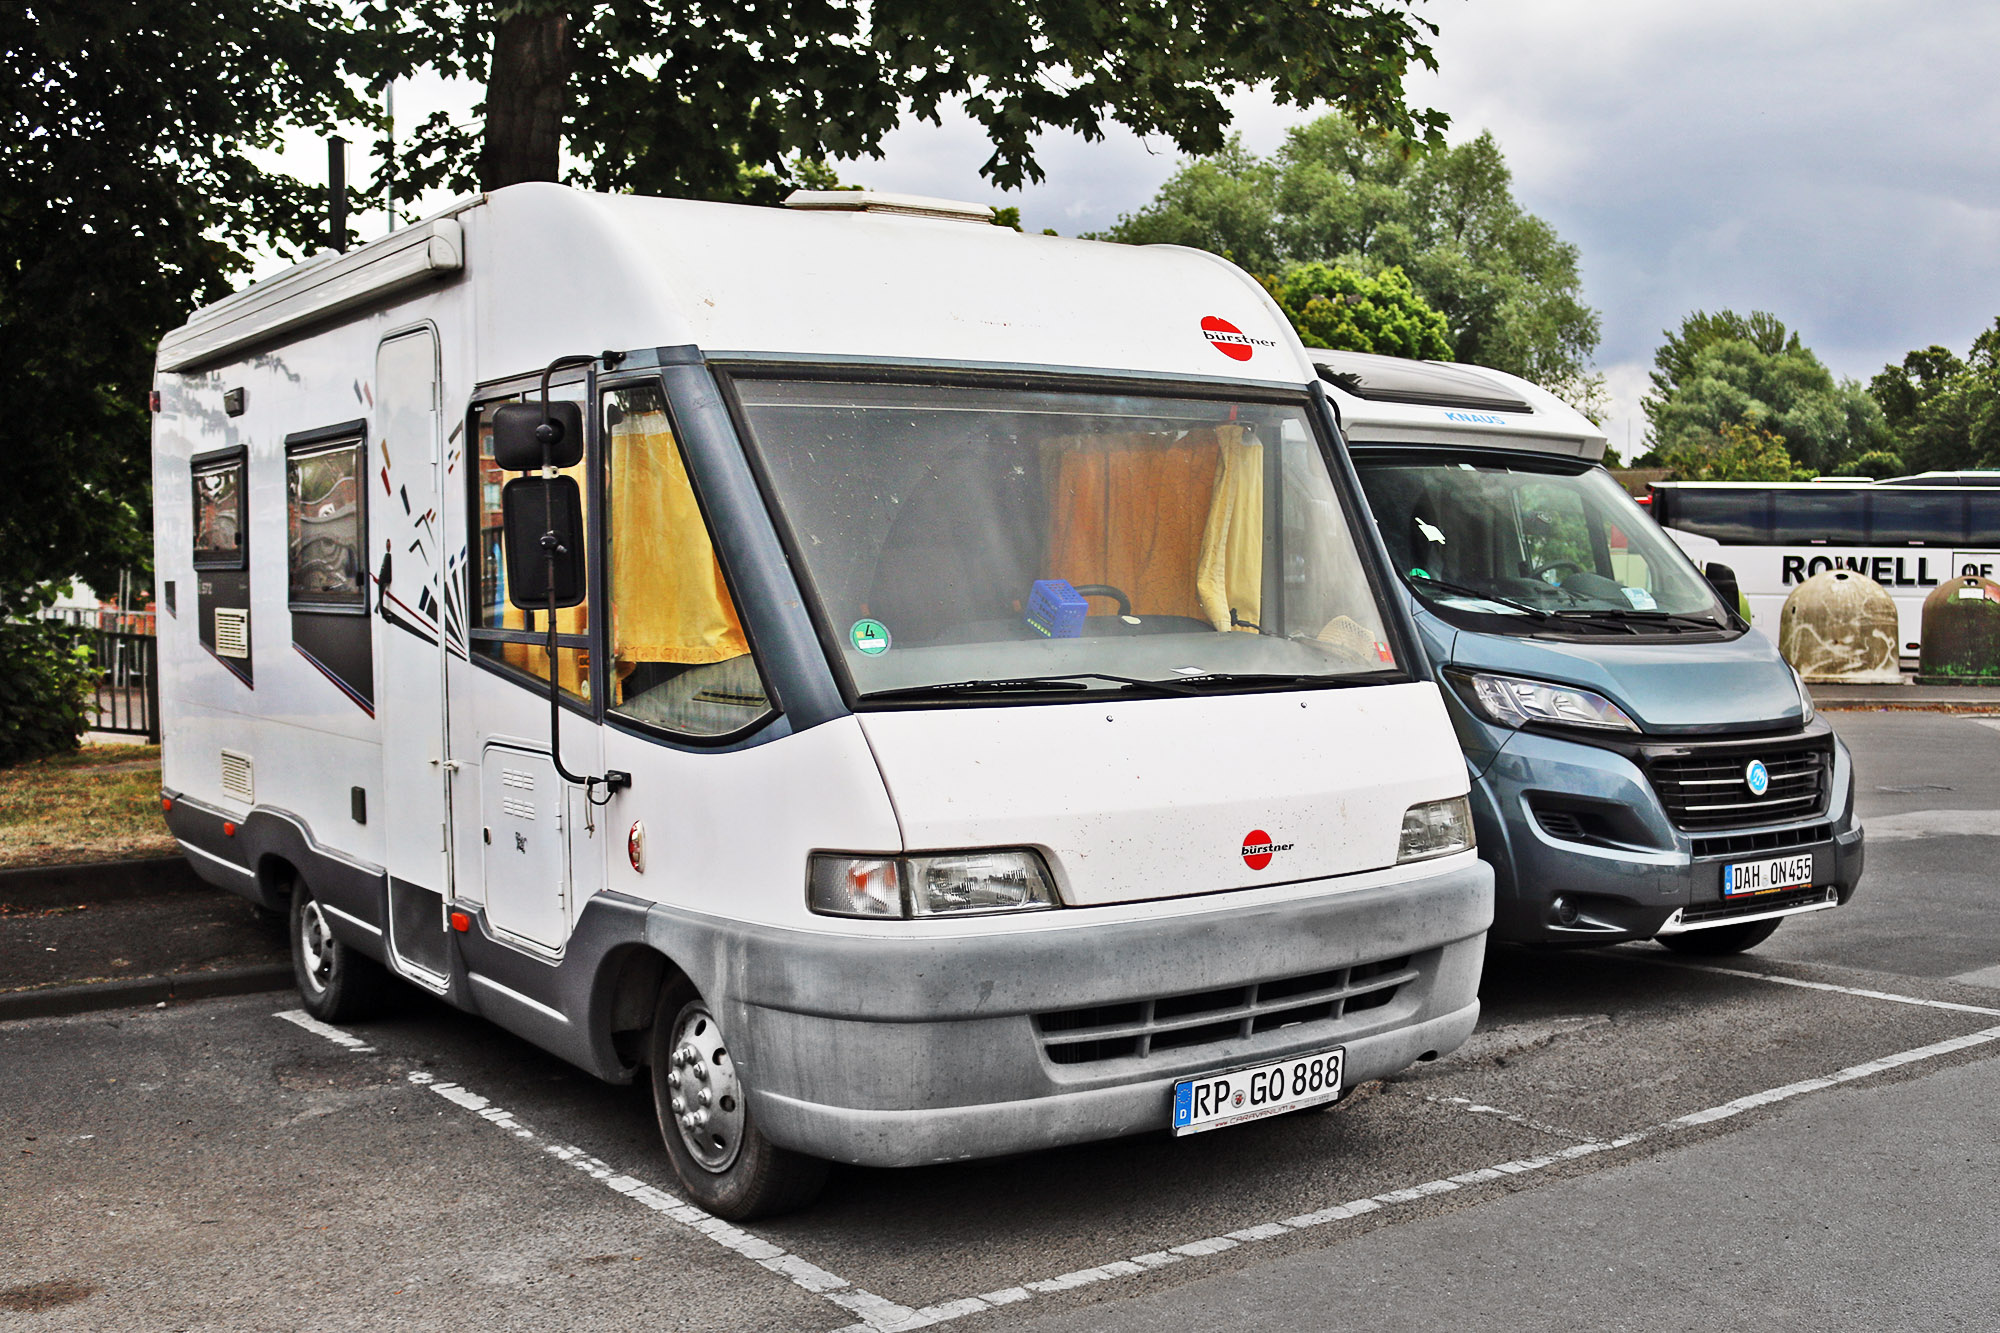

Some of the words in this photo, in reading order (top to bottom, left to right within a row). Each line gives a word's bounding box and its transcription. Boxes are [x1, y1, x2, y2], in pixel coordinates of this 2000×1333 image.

[1203, 330, 1277, 347] bürstner
[1444, 412, 1505, 424] KNAUS
[865, 624, 875, 639] 4
[1241, 843, 1294, 855] bürstner
[1734, 864, 1760, 890] DAH
[1179, 1108, 1188, 1120] D
[1193, 1079, 1231, 1119] RP
[1250, 1067, 1285, 1106] GO
[1292, 1055, 1340, 1096] 888
